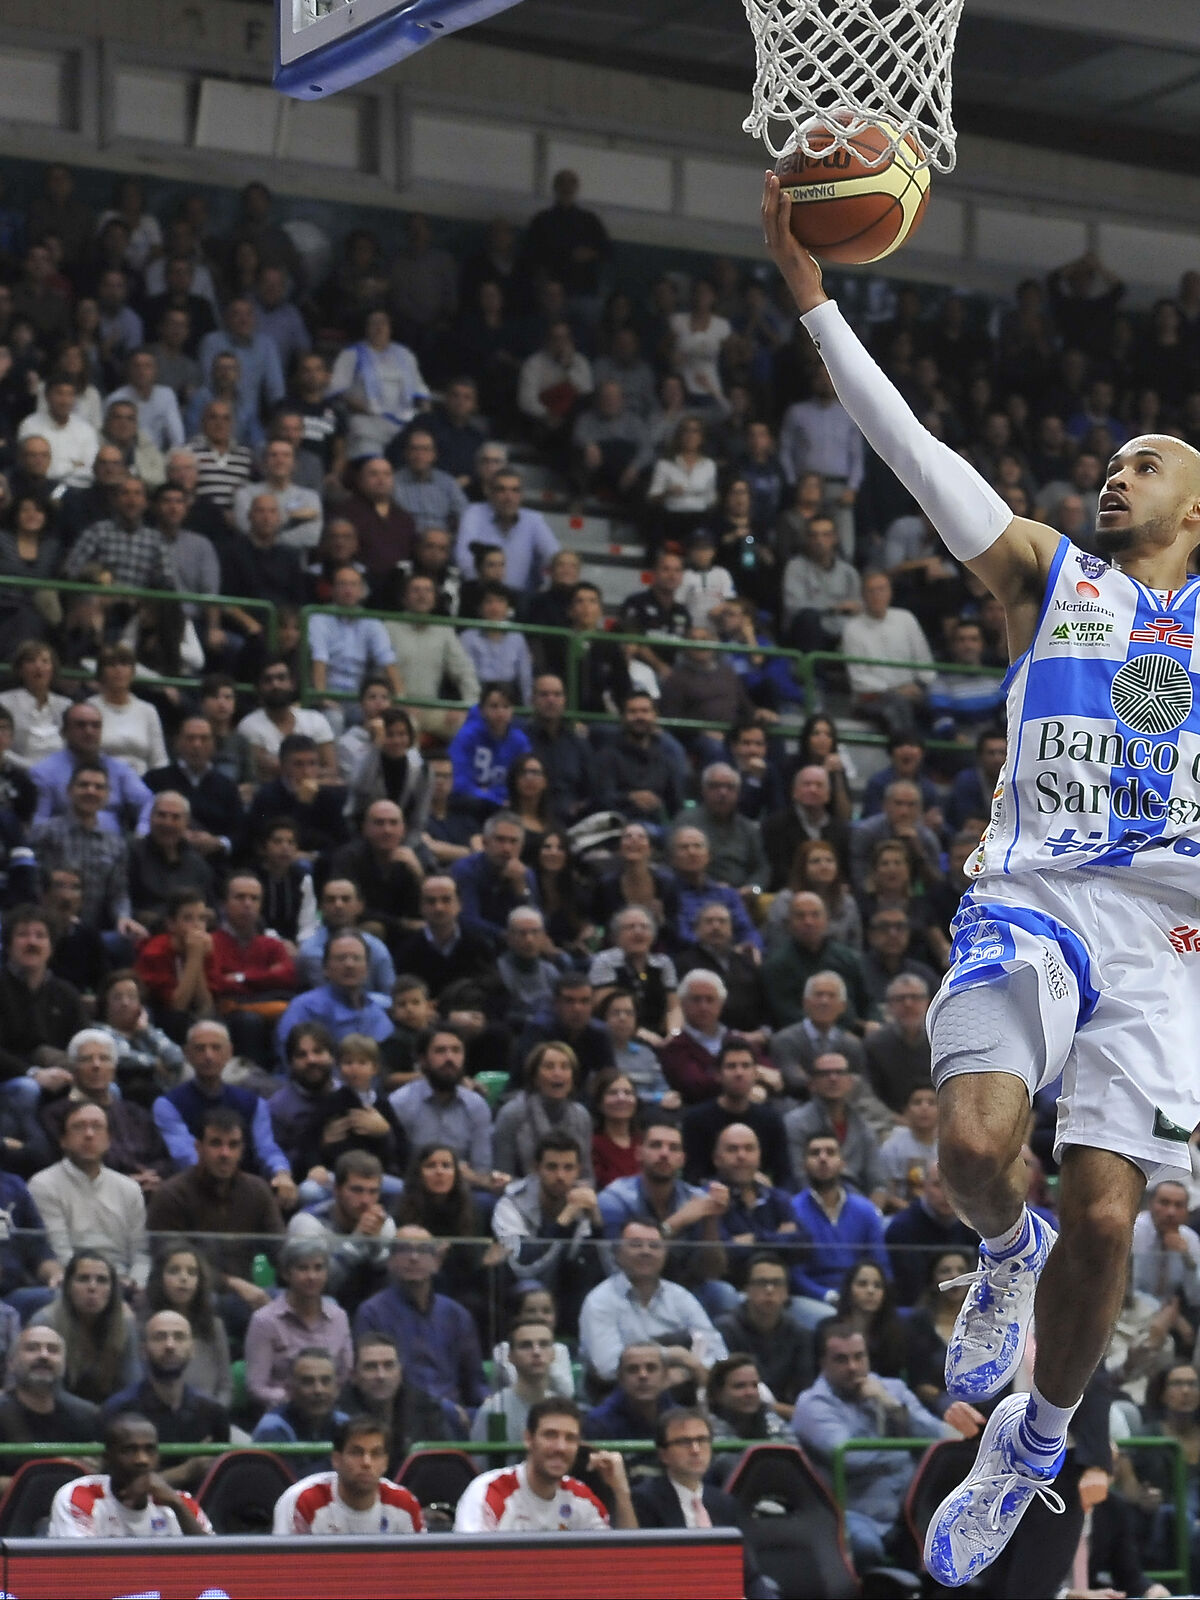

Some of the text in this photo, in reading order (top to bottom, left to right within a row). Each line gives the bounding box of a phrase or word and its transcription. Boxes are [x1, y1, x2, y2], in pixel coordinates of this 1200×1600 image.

[793, 184, 835, 199] DINAMO
[1054, 599, 1115, 618] Meridiana
[1070, 622, 1114, 633] VERDE
[1076, 632, 1105, 642] VITA
[1036, 721, 1179, 774] Banco
